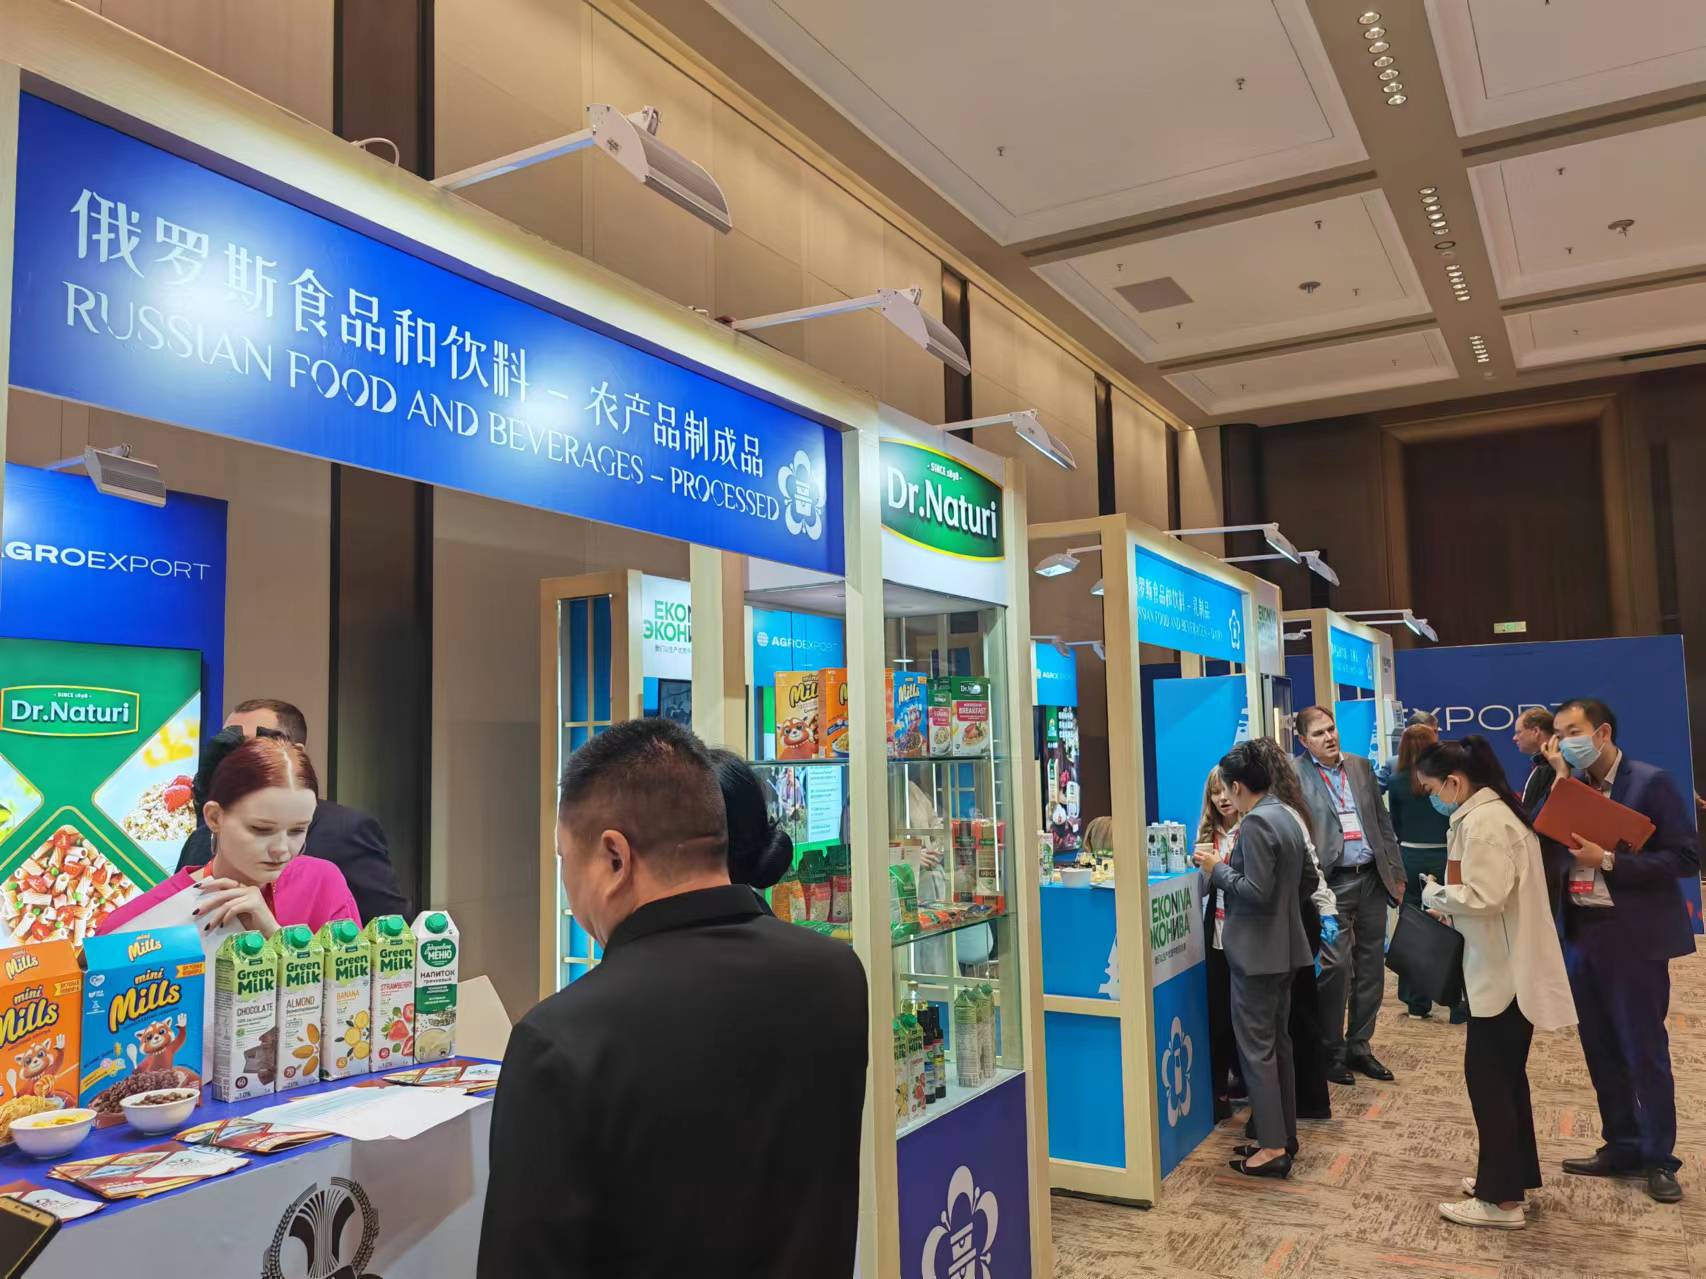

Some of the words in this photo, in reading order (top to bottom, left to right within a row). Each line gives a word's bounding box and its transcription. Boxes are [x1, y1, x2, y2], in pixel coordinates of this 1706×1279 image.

[70, 188, 529, 402] 俄罗斯食品和饮料
[584, 381, 764, 478] 农产品制成品
[62, 280, 273, 382] RUSSIAN
[286, 349, 398, 414] FOOD
[407, 390, 480, 437] AND
[489, 412, 644, 486] BEVERAGES
[671, 466, 780, 521] PROCESSED
[887, 466, 997, 539] Dr.Naturi
[1, 540, 212, 581] GROEXPORT
[790, 682, 818, 707] Mil
[11, 700, 129, 723] Dr.Naturi
[1152, 886, 1192, 923] EKONIVA
[1151, 911, 1191, 951] КОНИВА
[128, 938, 162, 961] Mills
[380, 949, 412, 958] Green
[428, 949, 452, 960] МЕНЮ
[5, 955, 39, 980] Mills
[286, 962, 320, 972] Green
[336, 955, 368, 966] Green
[380, 957, 412, 973] Milk
[135, 967, 164, 985] mini
[237, 968, 274, 980] Green
[286, 970, 320, 987] Milk
[336, 964, 368, 981] Milk
[420, 970, 455, 978] НАПИТОК
[14, 984, 43, 1005] mini
[237, 978, 274, 995] Milk
[336, 990, 359, 1000] BANANA
[109, 979, 181, 1033] Mills
[237, 1002, 273, 1017] CHOCOLATE
[287, 996, 315, 1008] ALMOND
[0, 998, 59, 1048] Mills
